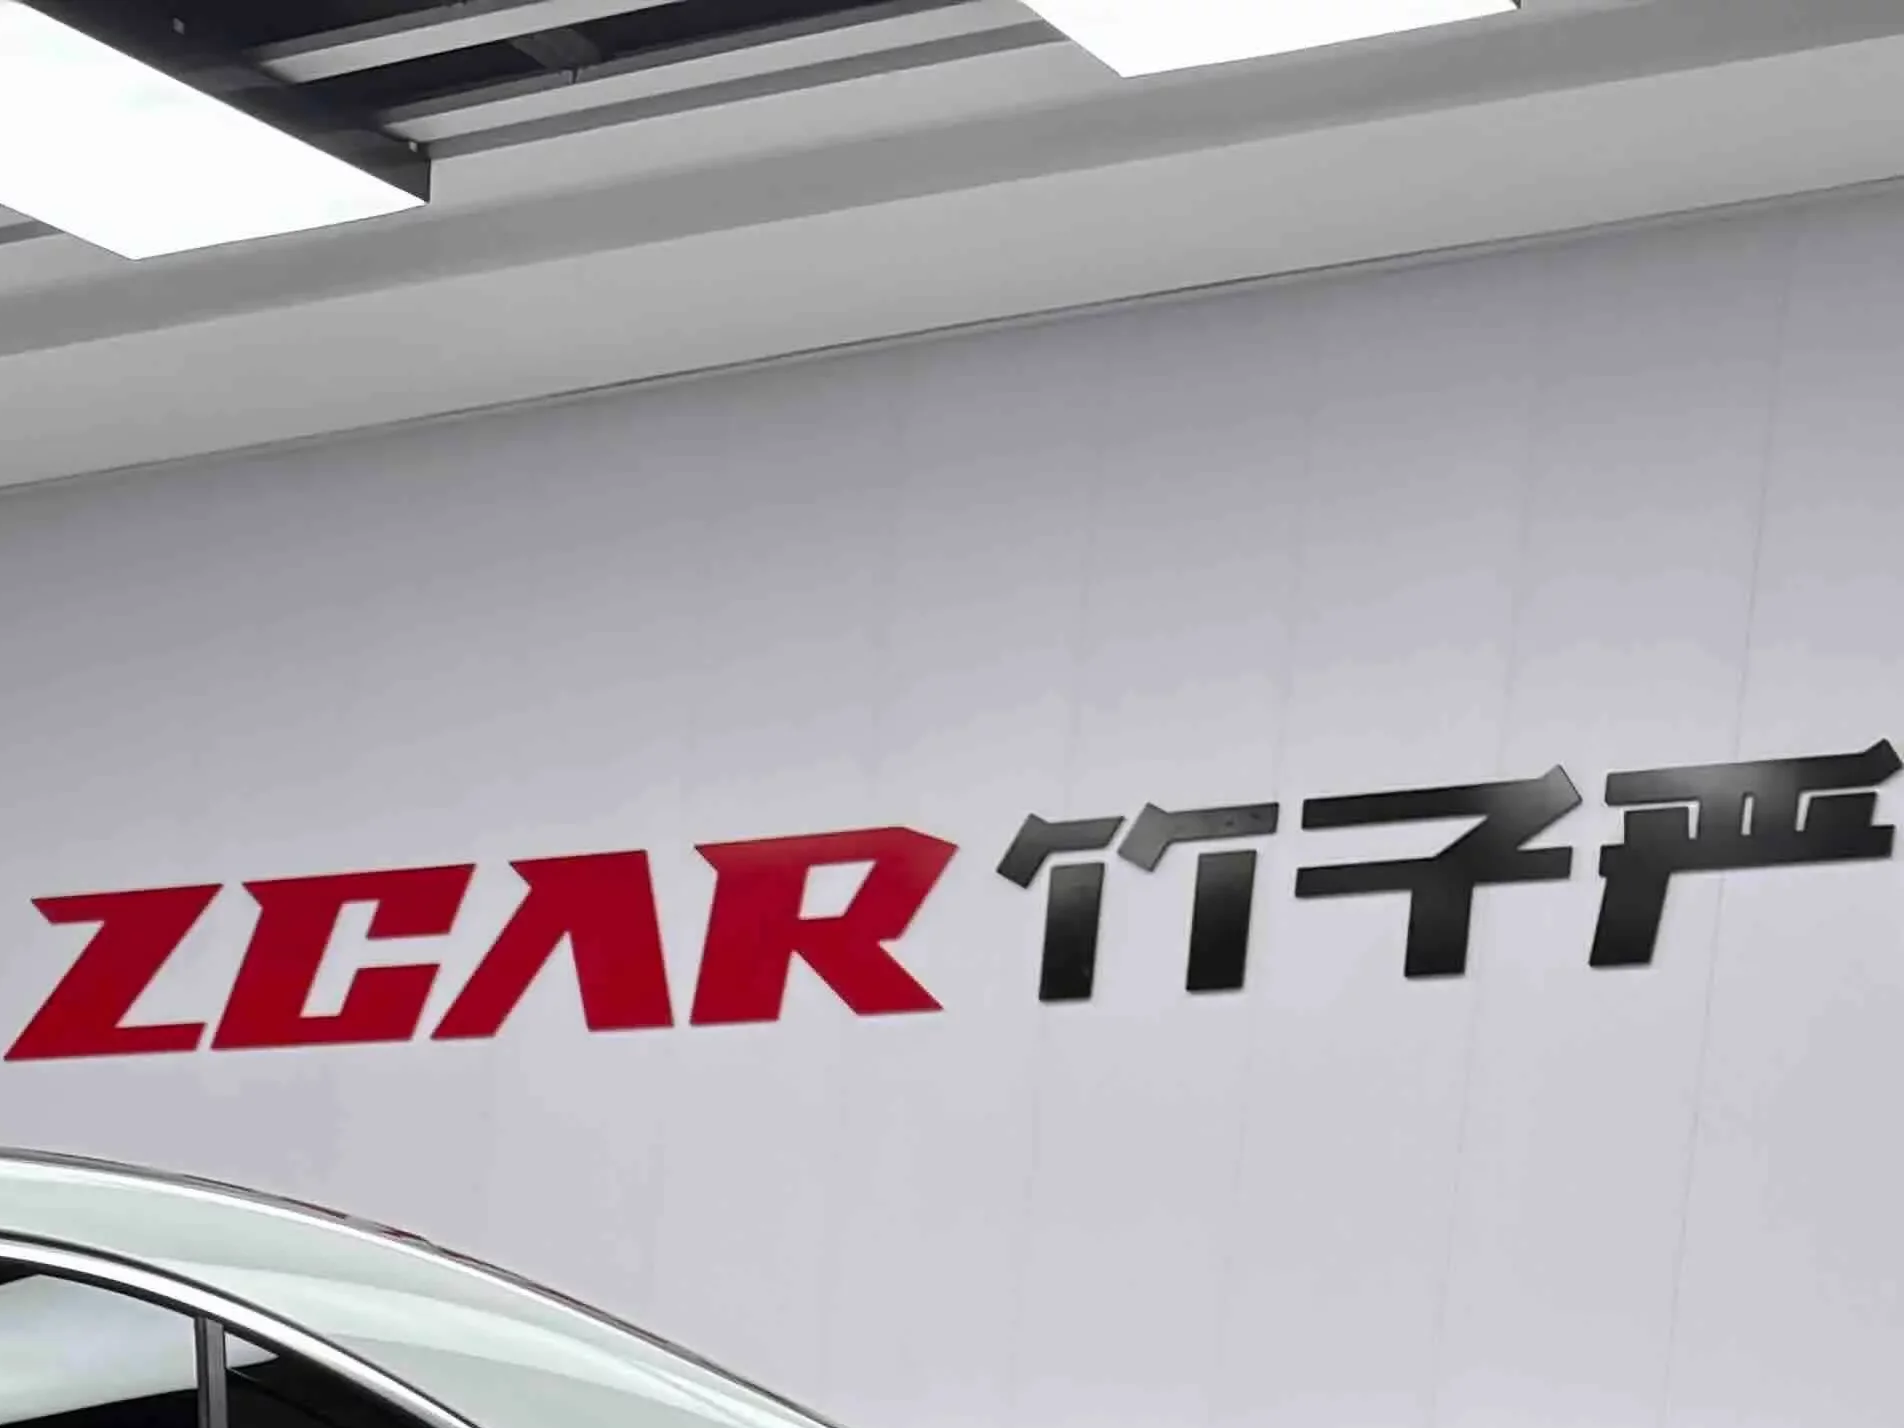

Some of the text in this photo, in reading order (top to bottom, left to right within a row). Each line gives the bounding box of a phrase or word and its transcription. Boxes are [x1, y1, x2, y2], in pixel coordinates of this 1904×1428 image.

[6, 739, 1903, 1060] ZCAR 竹子严
